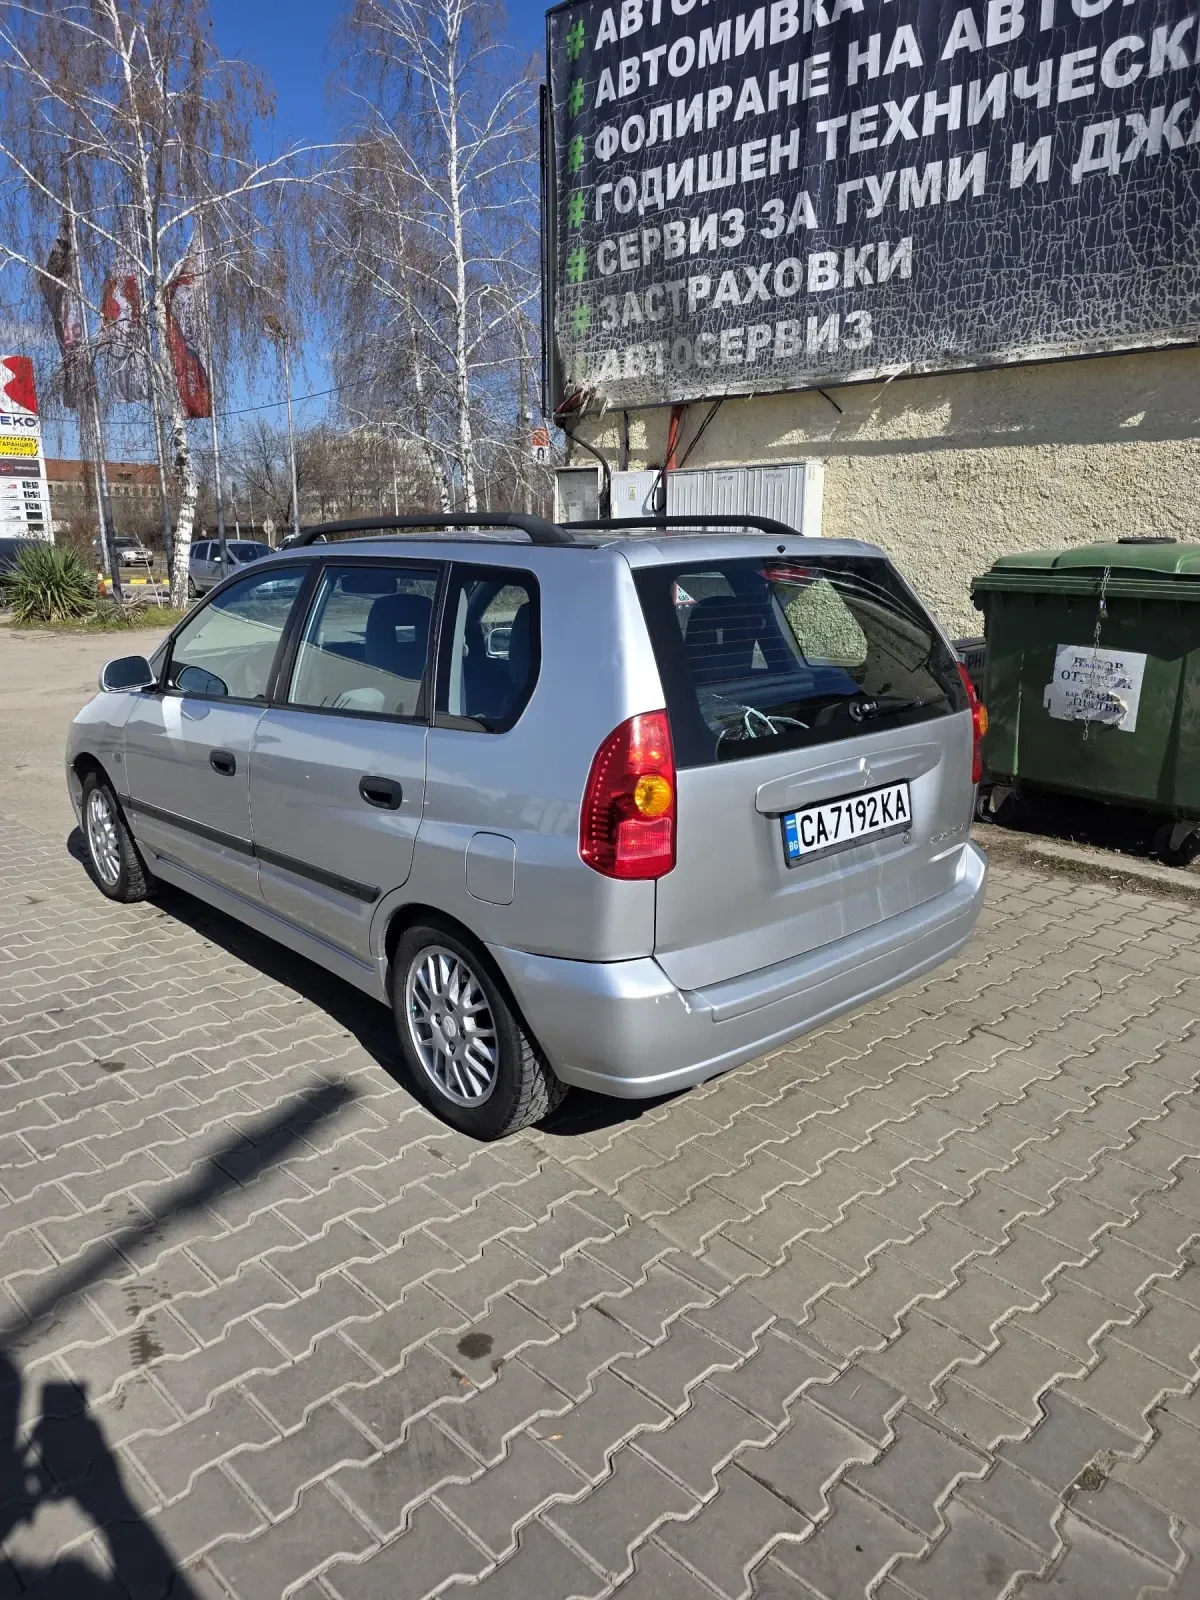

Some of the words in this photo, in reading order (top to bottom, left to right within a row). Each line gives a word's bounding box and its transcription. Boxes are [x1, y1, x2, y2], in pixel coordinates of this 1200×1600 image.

[594, 52, 830, 162] ФОЛИРАНЕ
[847, 24, 923, 86] НА
[595, 128, 800, 221] ГОДИШЕН
[816, 16, 1200, 161] ТЕХНИЧЕСК
[597, 208, 746, 276] СЕРВИЗ
[760, 191, 818, 239] ЗА
[836, 151, 988, 225] ГУМИ
[1009, 134, 1052, 189] И
[600, 236, 912, 331] ЗАСТРАХОВКИ
[598, 309, 873, 383] АВТОСЕРВИЗ
[0, 415, 37, 427] EKO
[789, 841, 798, 852] BG
